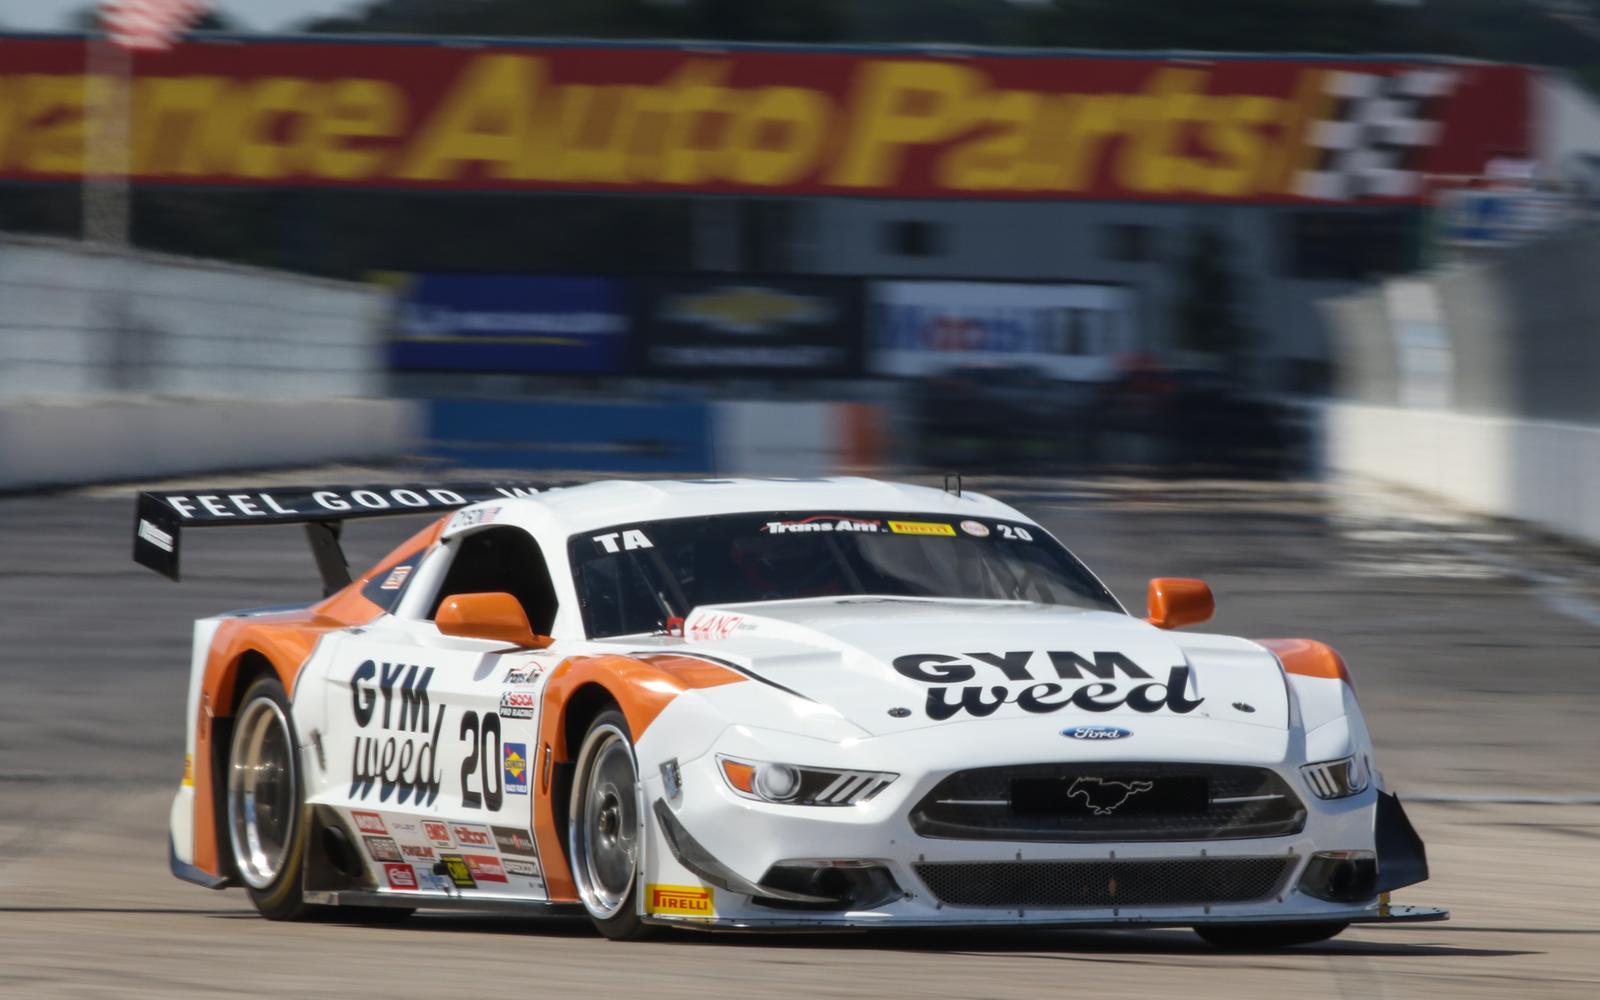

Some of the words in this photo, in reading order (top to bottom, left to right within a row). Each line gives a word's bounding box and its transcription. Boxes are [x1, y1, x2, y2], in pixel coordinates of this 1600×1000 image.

[0, 73, 412, 181] ance
[400, 52, 828, 186] Auto
[830, 60, 1292, 194] Parts
[165, 493, 299, 519] FEEL
[766, 521, 834, 535] Trans
[835, 520, 878, 533] Am
[996, 523, 1034, 542] 20
[592, 529, 654, 553] TA
[892, 651, 1153, 684] GYM
[351, 659, 435, 733] GYM
[510, 693, 534, 706] SCCA
[925, 665, 1206, 721] weed
[500, 707, 512, 717] PRO
[512, 708, 534, 718] RACING
[1074, 727, 1120, 739] Ford
[349, 704, 446, 807] weed
[459, 710, 503, 812] 20
[653, 889, 709, 911] PIRELLI
